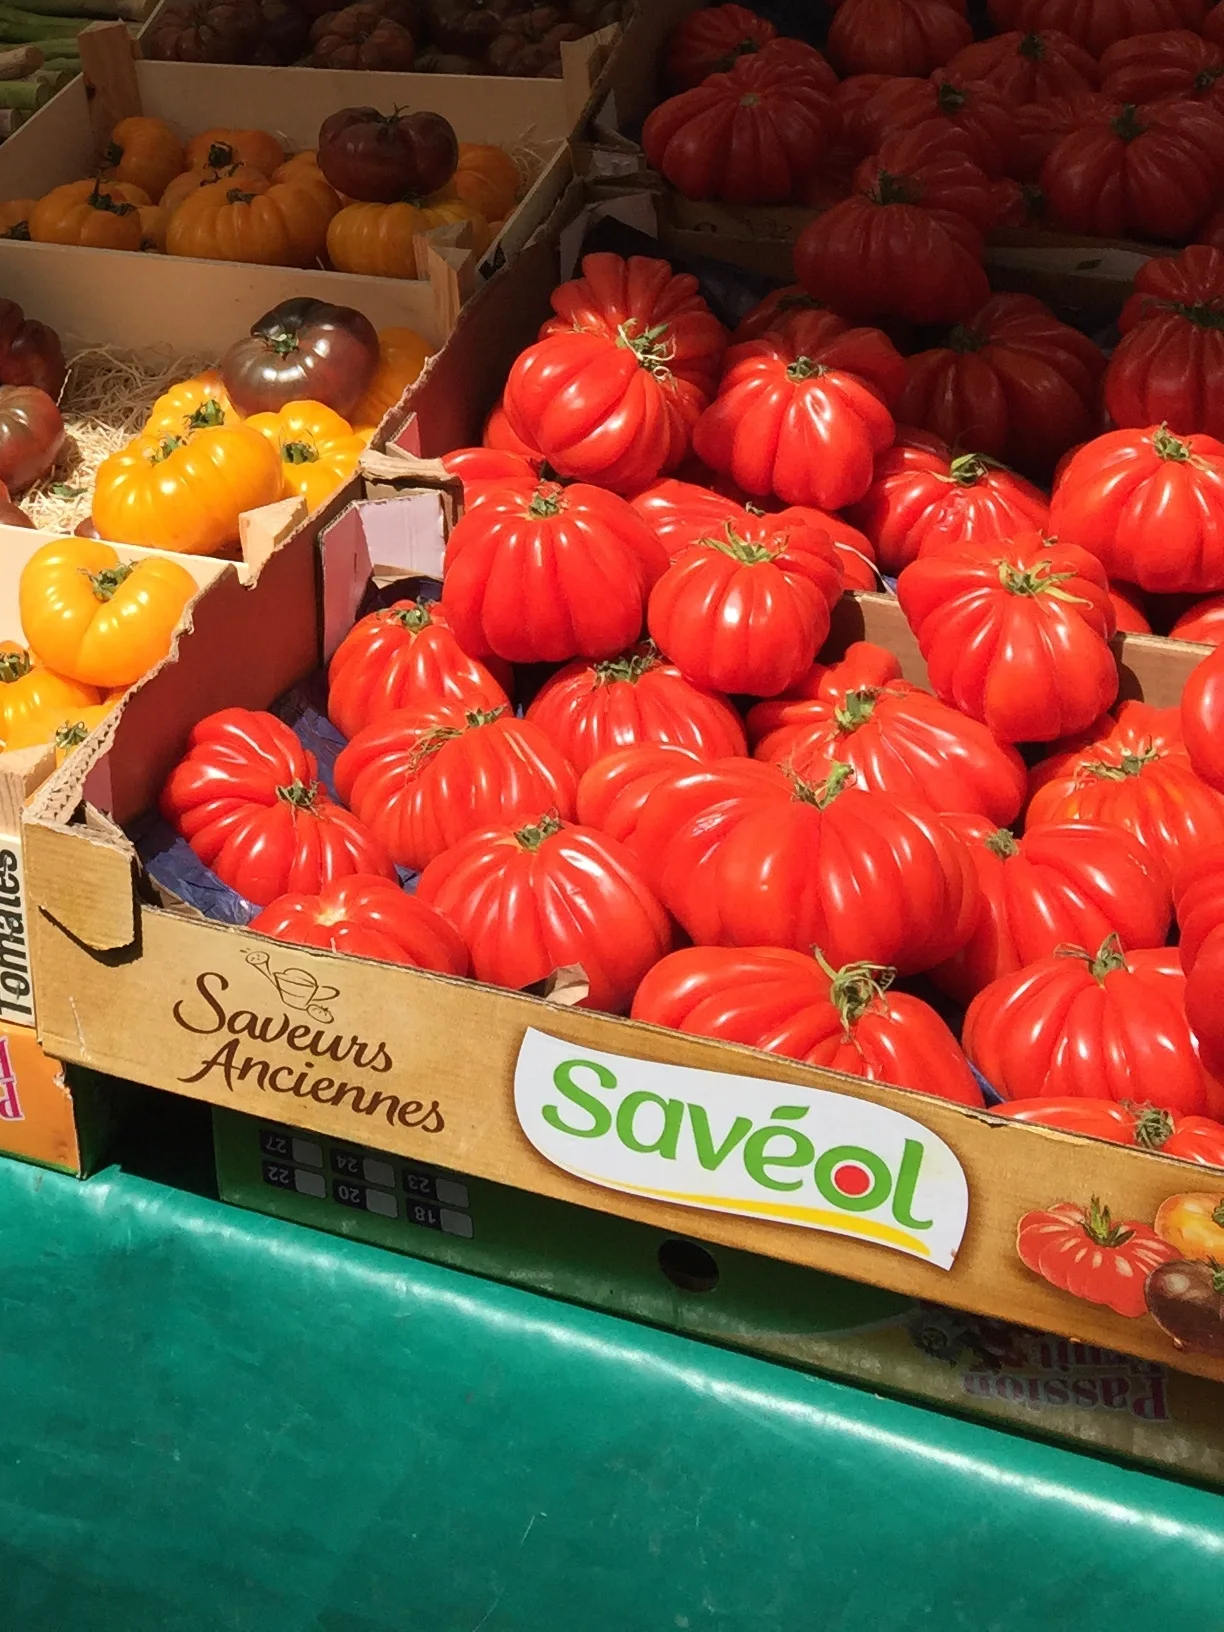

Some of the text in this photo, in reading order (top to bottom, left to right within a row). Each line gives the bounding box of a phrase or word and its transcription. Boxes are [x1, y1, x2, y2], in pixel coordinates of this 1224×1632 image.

[173, 971, 393, 1073] Saveurs
[177, 1039, 445, 1135] Anciennes
[265, 1136, 431, 1193] 23 24 27
[540, 1059, 934, 1233] Savéol
[268, 1166, 436, 1223] 18 20 22
[962, 1374, 1168, 1420] Passion
